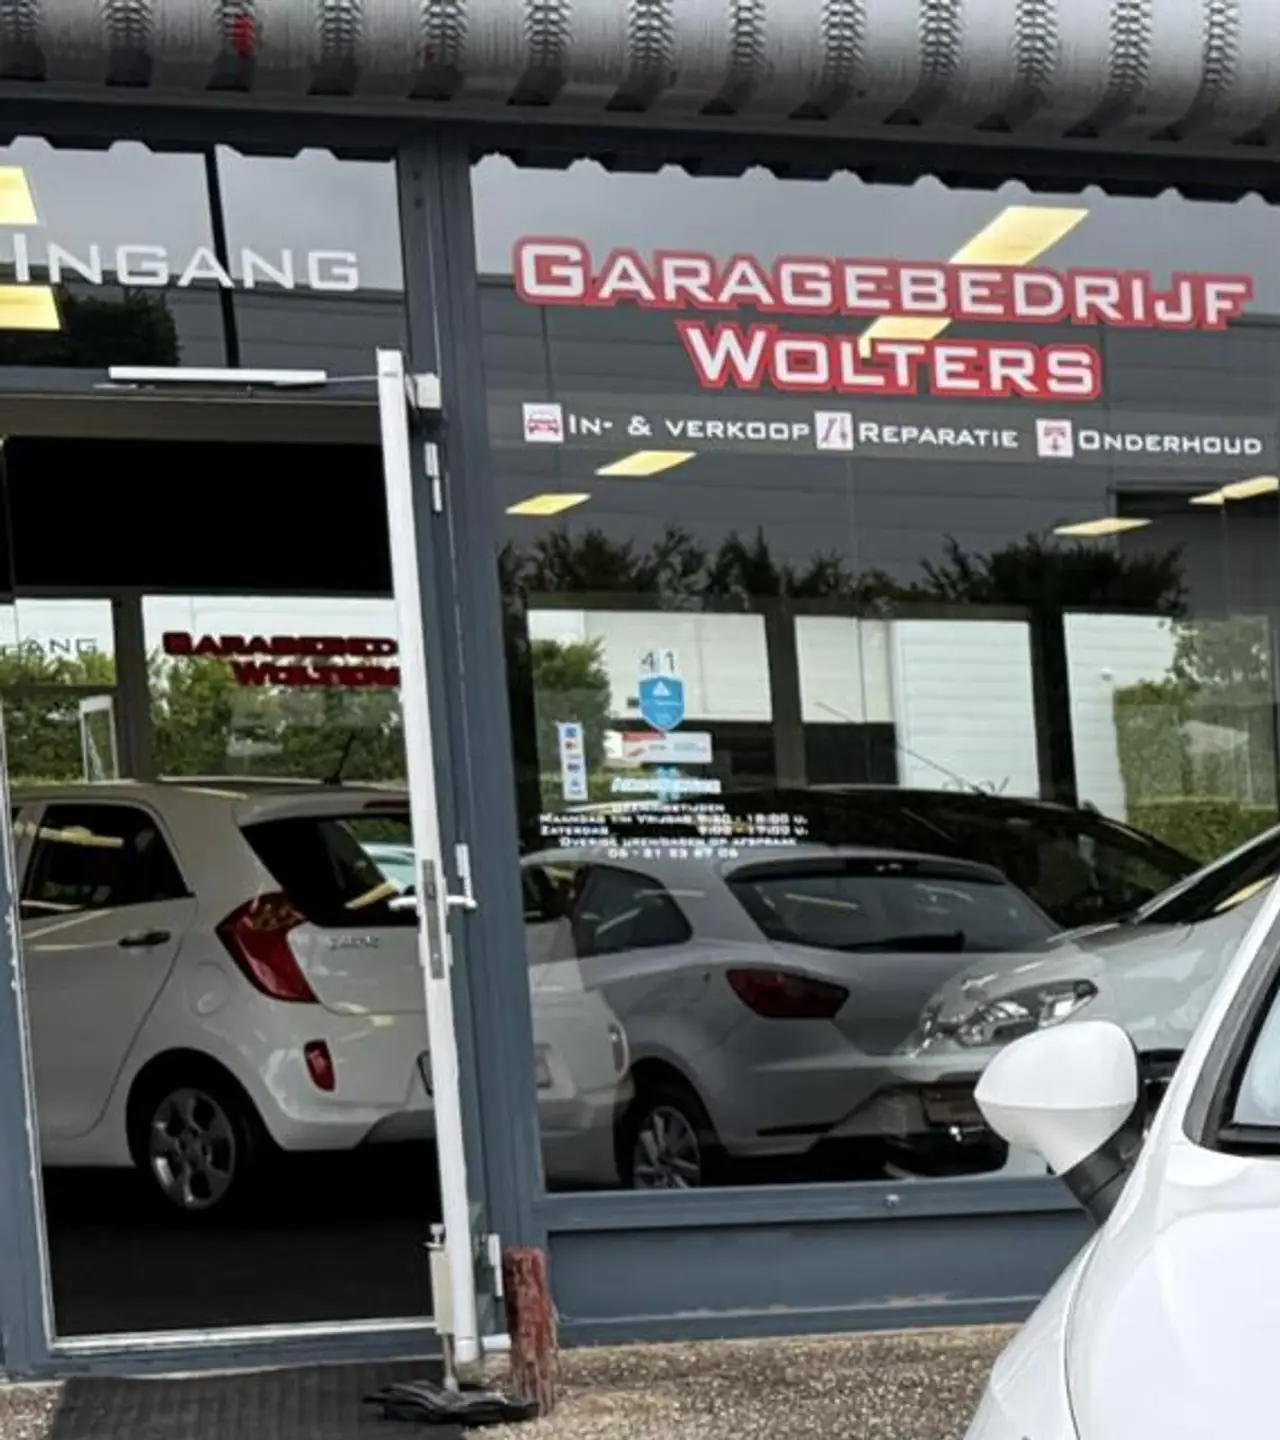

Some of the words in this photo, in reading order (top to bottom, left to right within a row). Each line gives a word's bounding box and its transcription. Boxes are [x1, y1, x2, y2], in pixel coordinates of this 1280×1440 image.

[13, 232, 360, 293] INGANG
[513, 236, 1253, 331] GARAGEBEDRIJF
[677, 320, 1101, 400] WOLTERS
[568, 411, 614, 438] IN-
[627, 415, 652, 437] &
[666, 419, 810, 443] VERKOOP
[859, 420, 1019, 449] REPARATIE
[1078, 429, 1263, 456] ONDERHOUD
